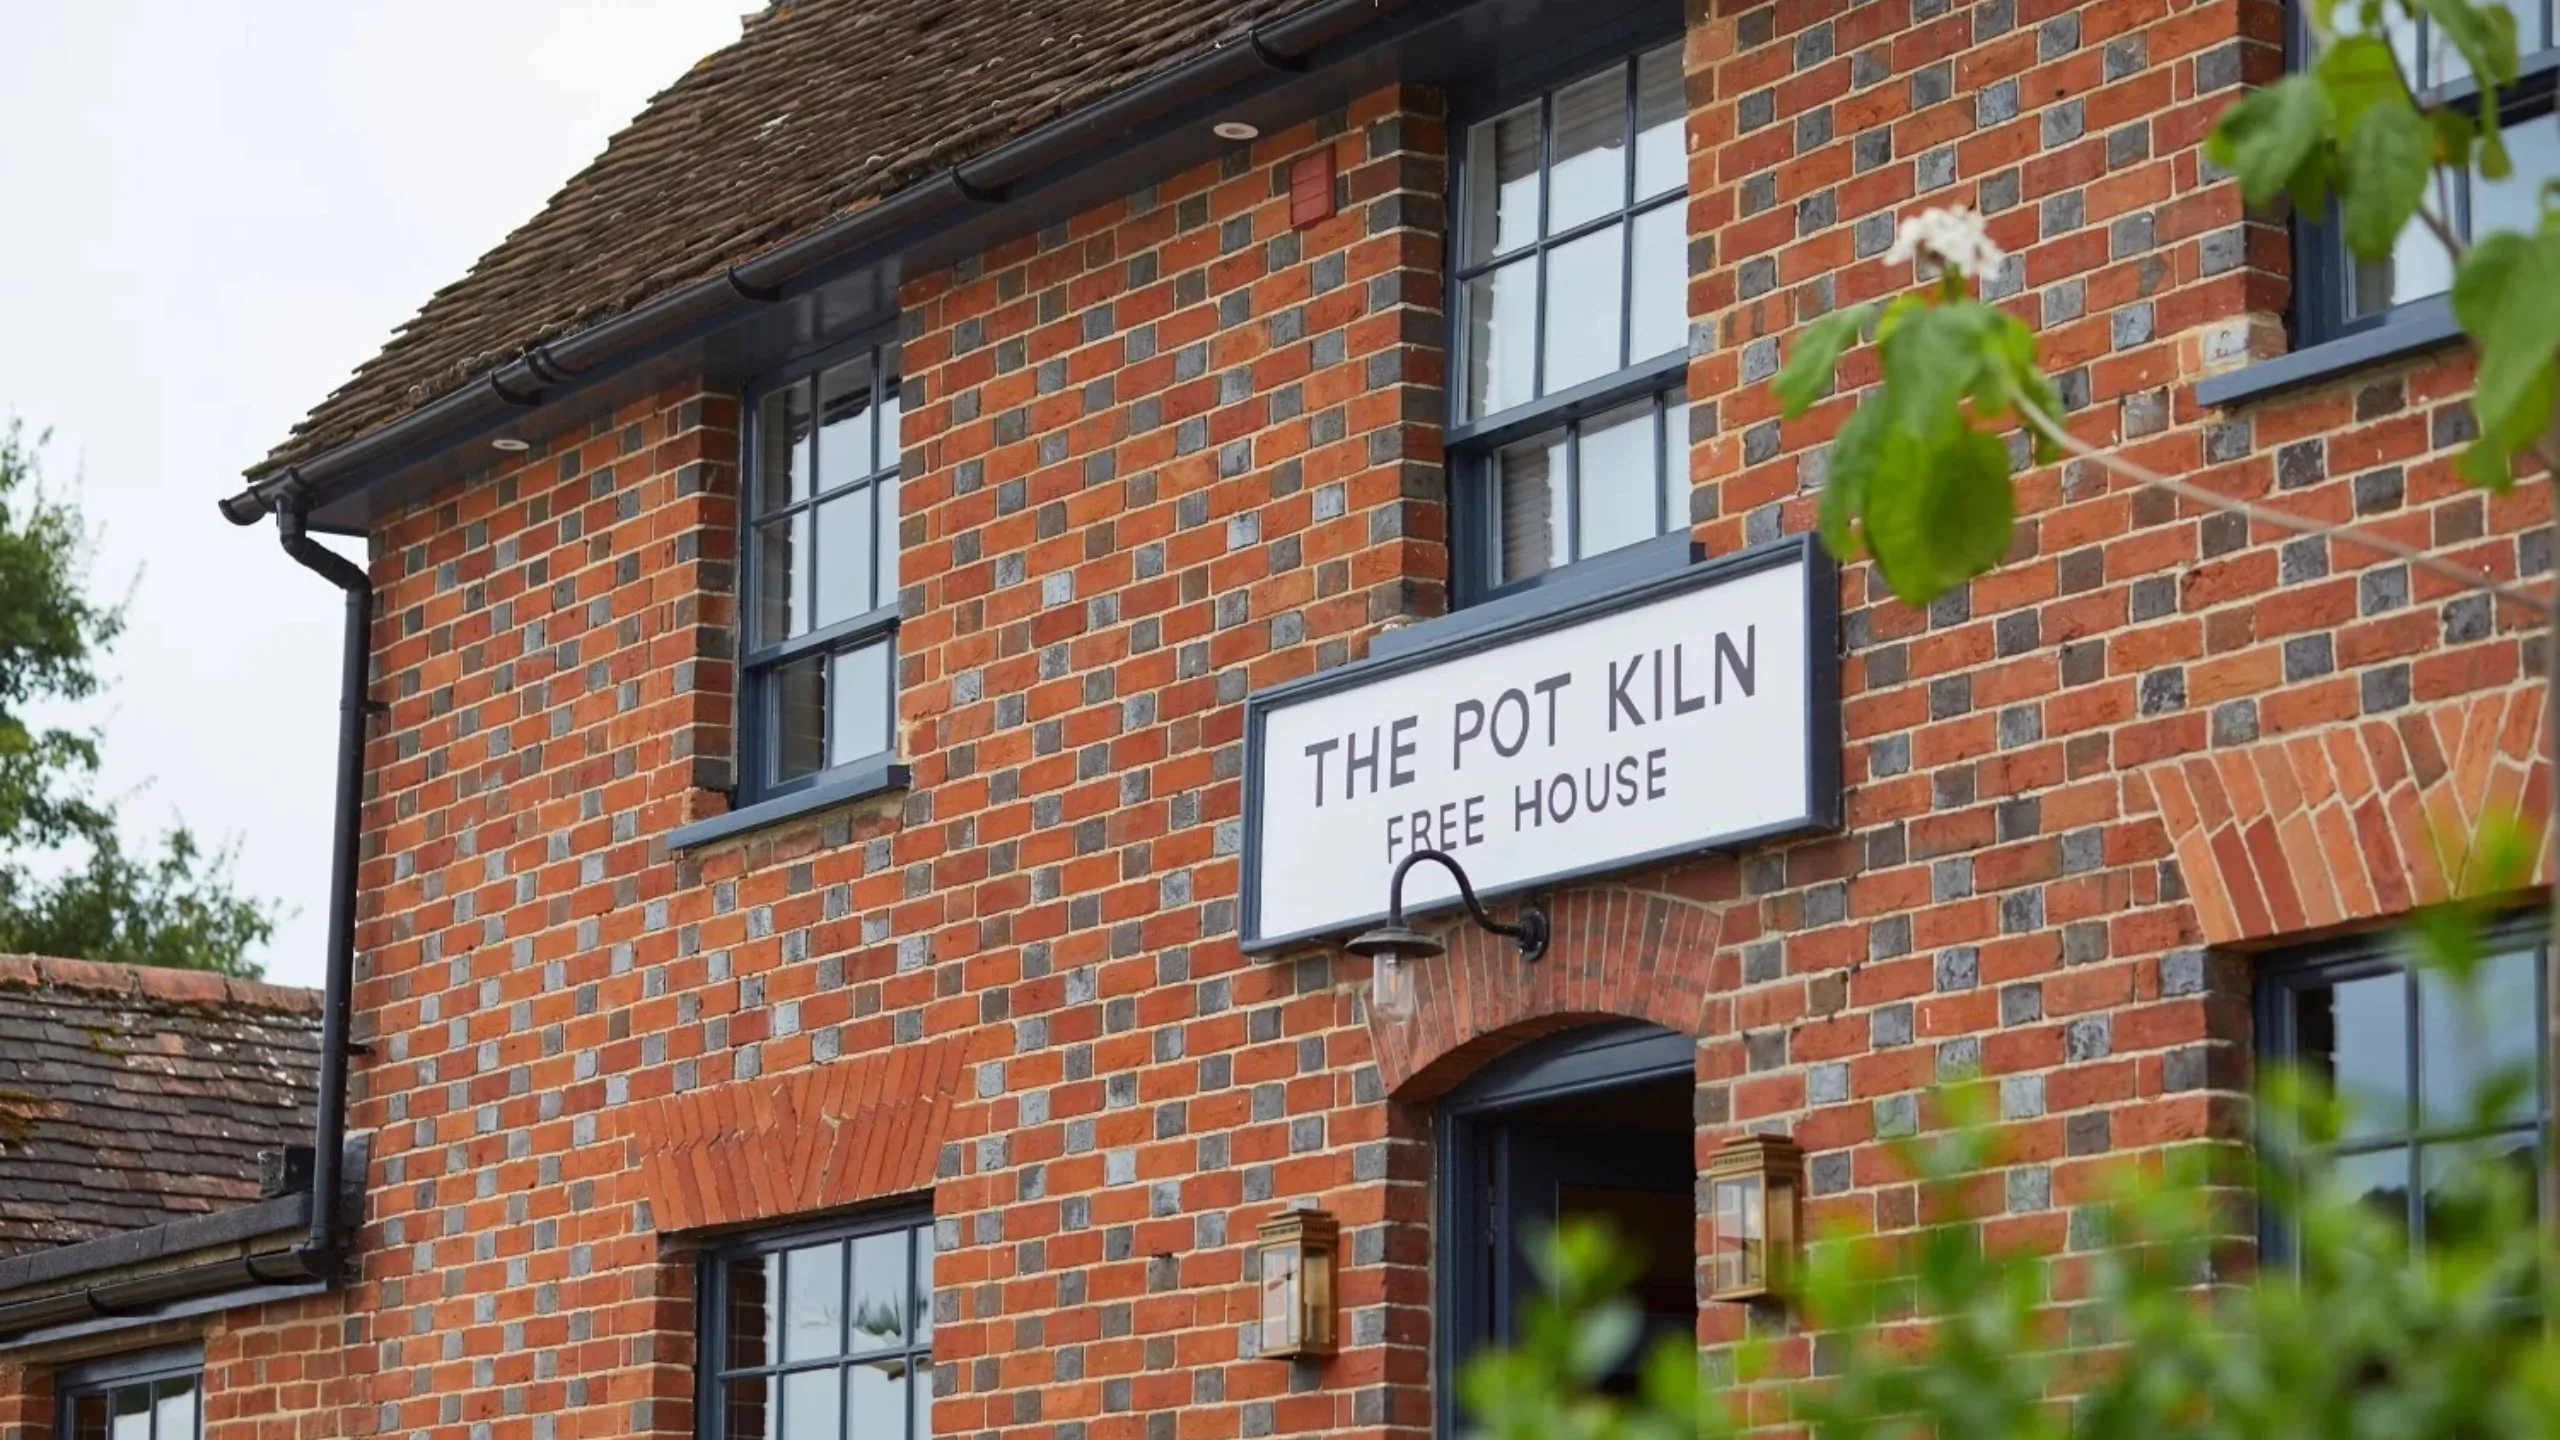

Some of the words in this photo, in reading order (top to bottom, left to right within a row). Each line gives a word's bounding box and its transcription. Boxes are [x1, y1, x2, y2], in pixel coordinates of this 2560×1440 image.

[1305, 715, 1418, 808] THE
[1453, 672, 1572, 770] POT
[1608, 624, 1756, 732] KILN
[1387, 795, 1485, 864] FREE
[1514, 747, 1667, 832] HOUSE
